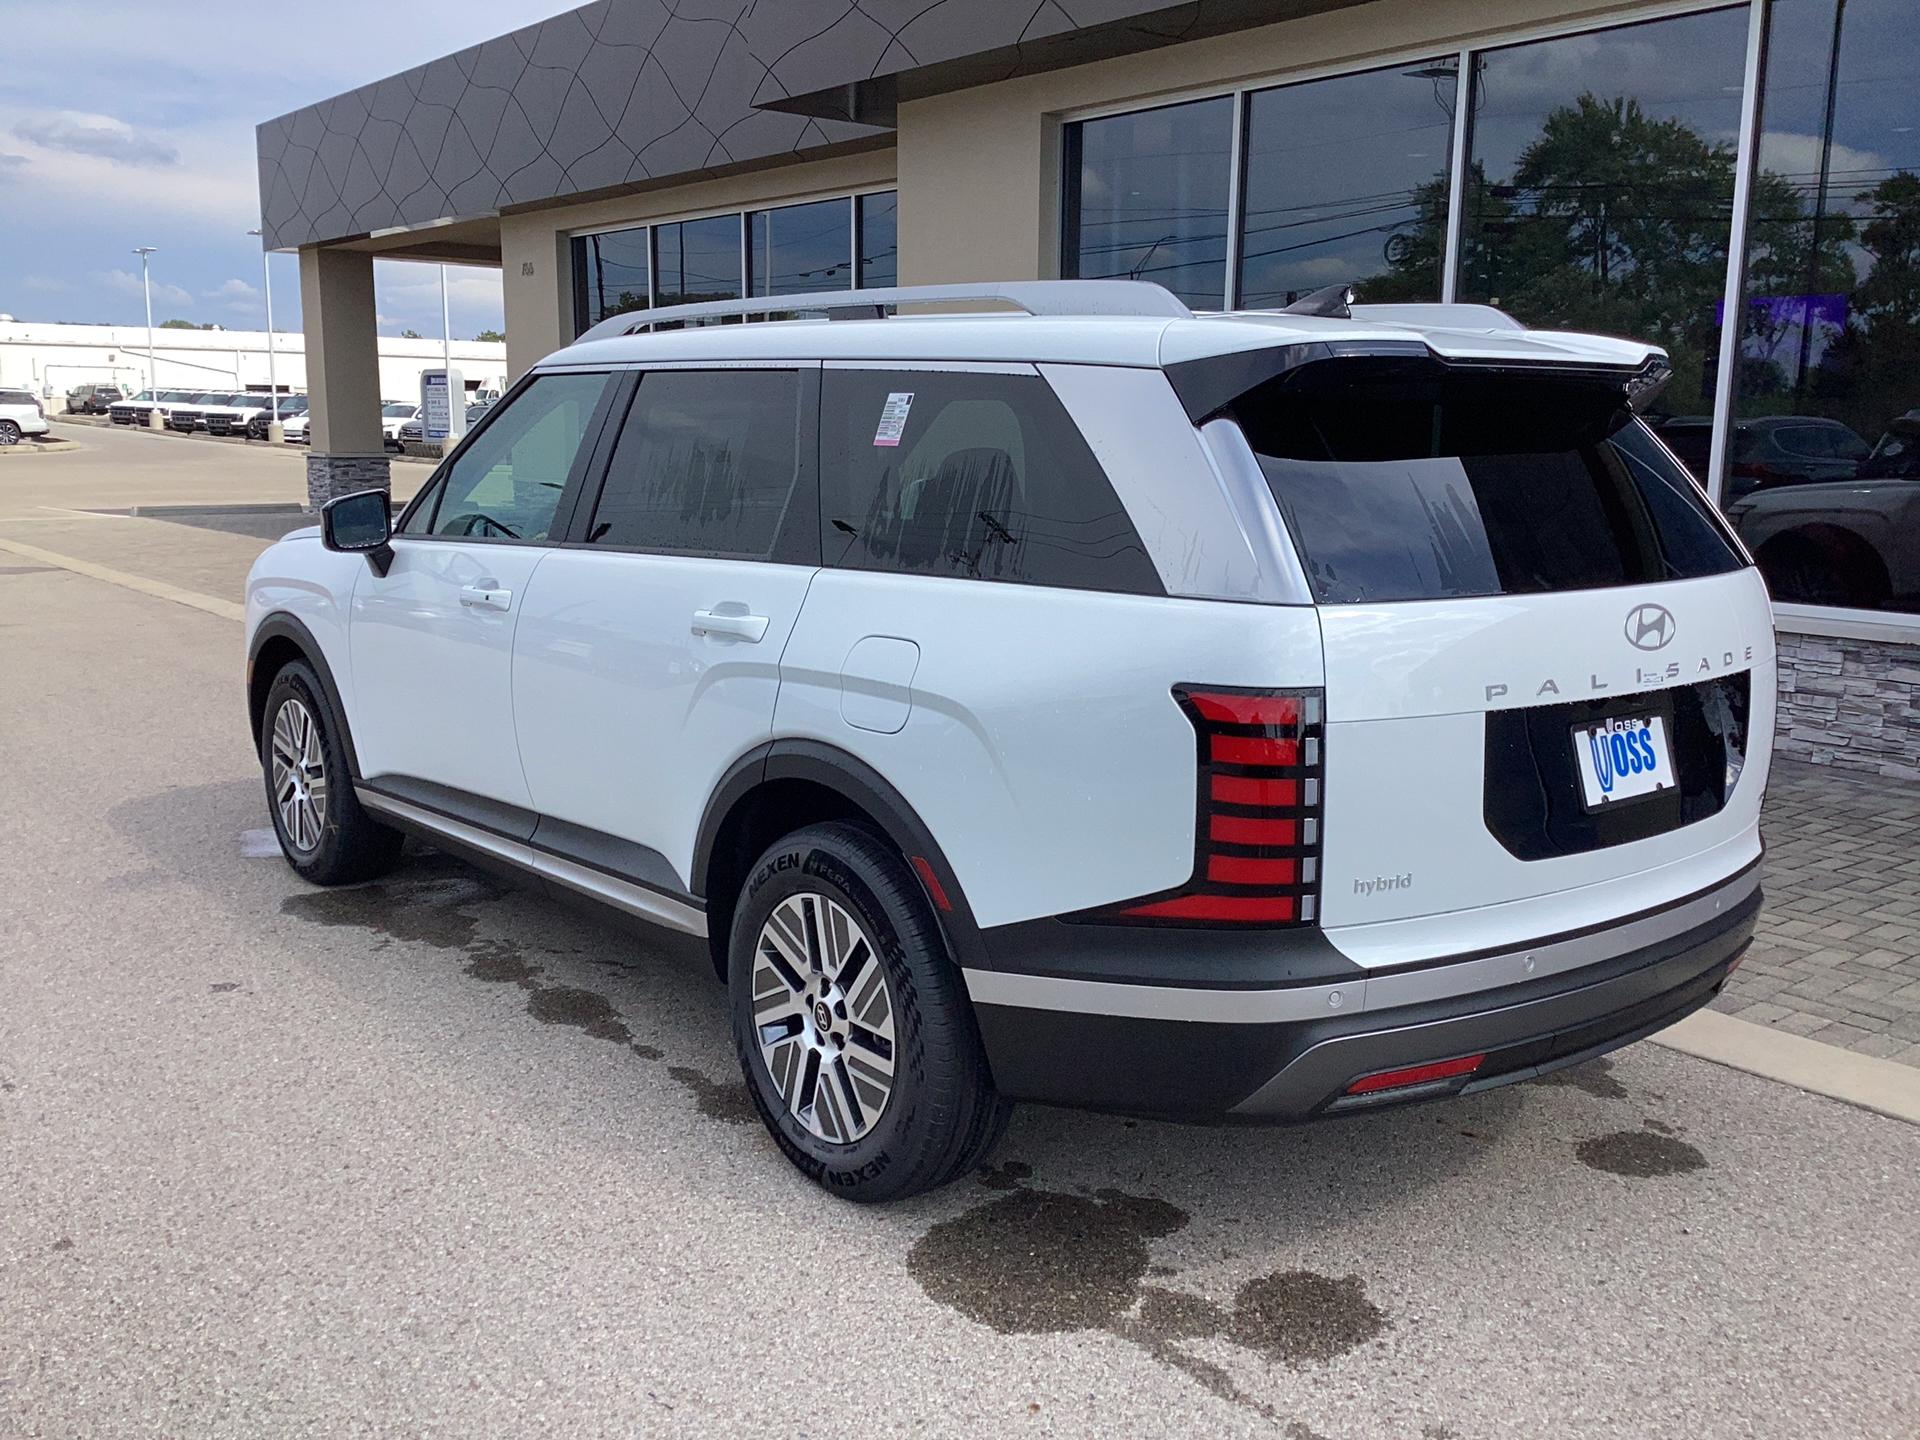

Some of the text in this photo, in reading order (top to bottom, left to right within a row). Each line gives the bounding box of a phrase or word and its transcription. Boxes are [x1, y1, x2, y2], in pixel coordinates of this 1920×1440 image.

[1485, 647, 1752, 702] PALISADE
[1590, 728, 1656, 793] VOSS
[748, 852, 800, 898] NEXEN
[1353, 872, 1413, 897] hybrid
[828, 1150, 891, 1187] NEXEN
